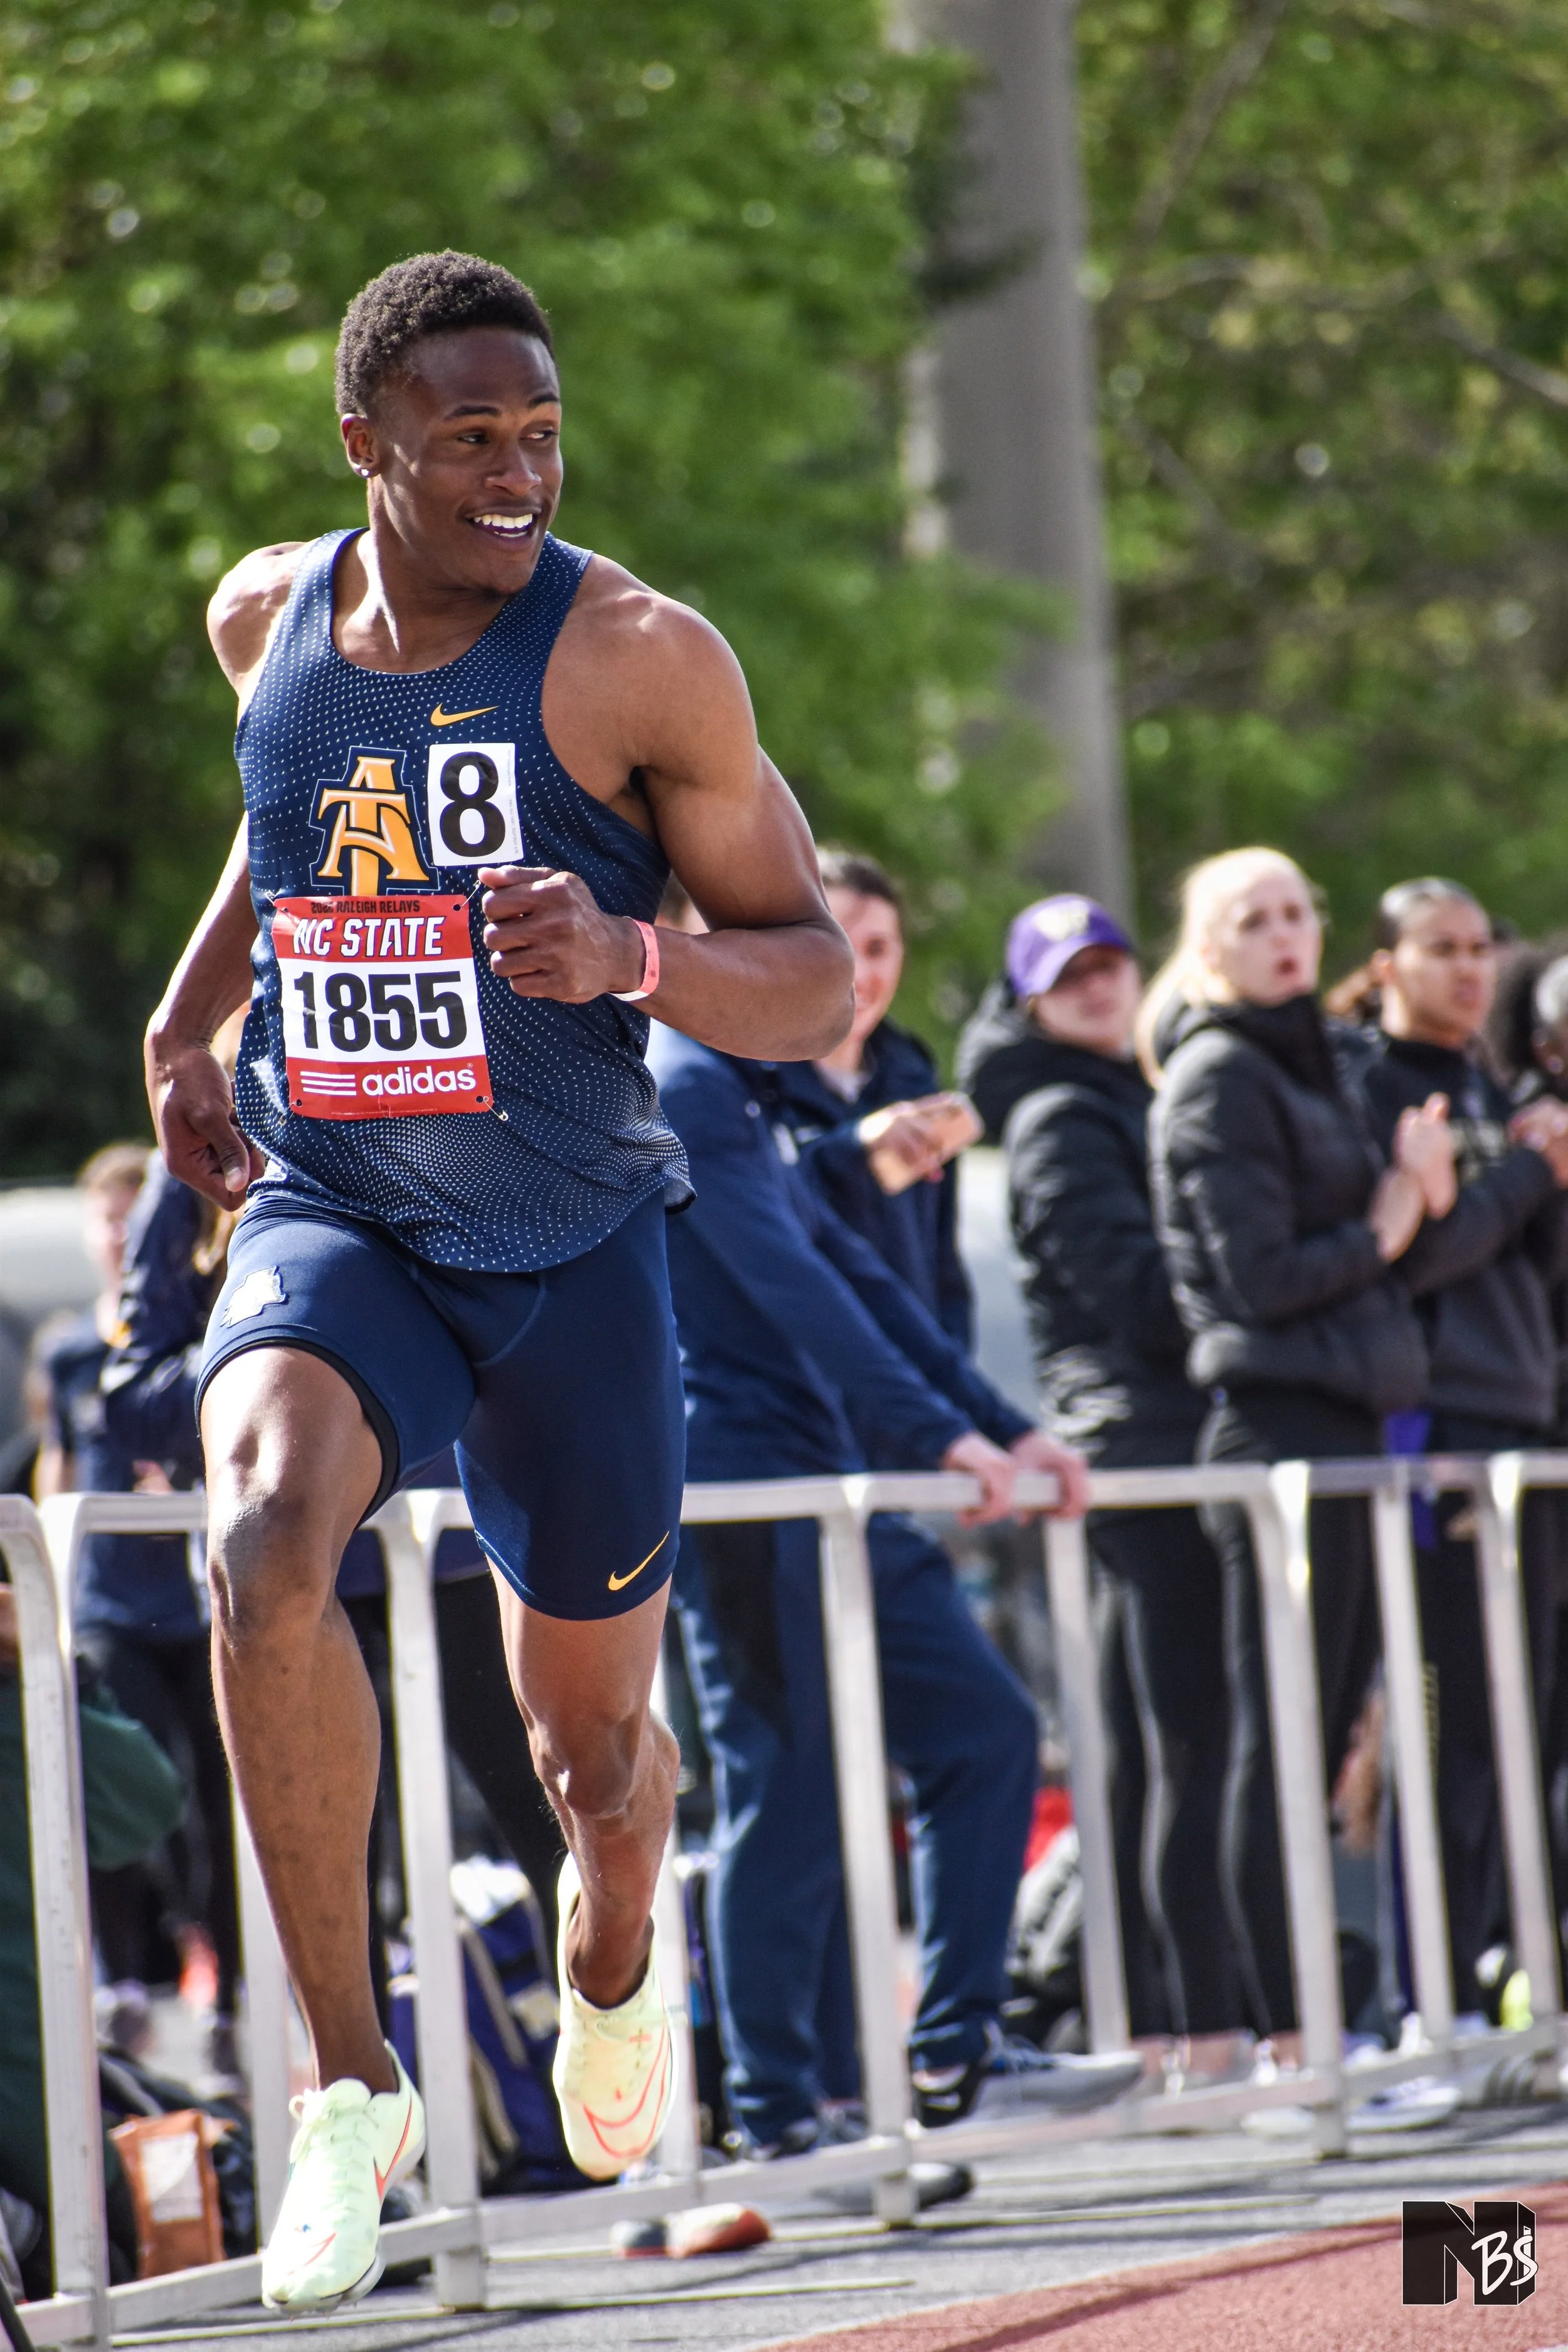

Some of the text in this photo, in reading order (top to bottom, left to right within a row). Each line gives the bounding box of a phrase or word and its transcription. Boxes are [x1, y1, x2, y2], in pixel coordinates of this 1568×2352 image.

[440, 751, 506, 857] 8
[336, 901, 376, 913] RALEIGH
[379, 900, 420, 913] RELAYS
[293, 916, 446, 956] NC STATE
[294, 971, 467, 1052] 1855
[362, 1066, 476, 1096] adidas
